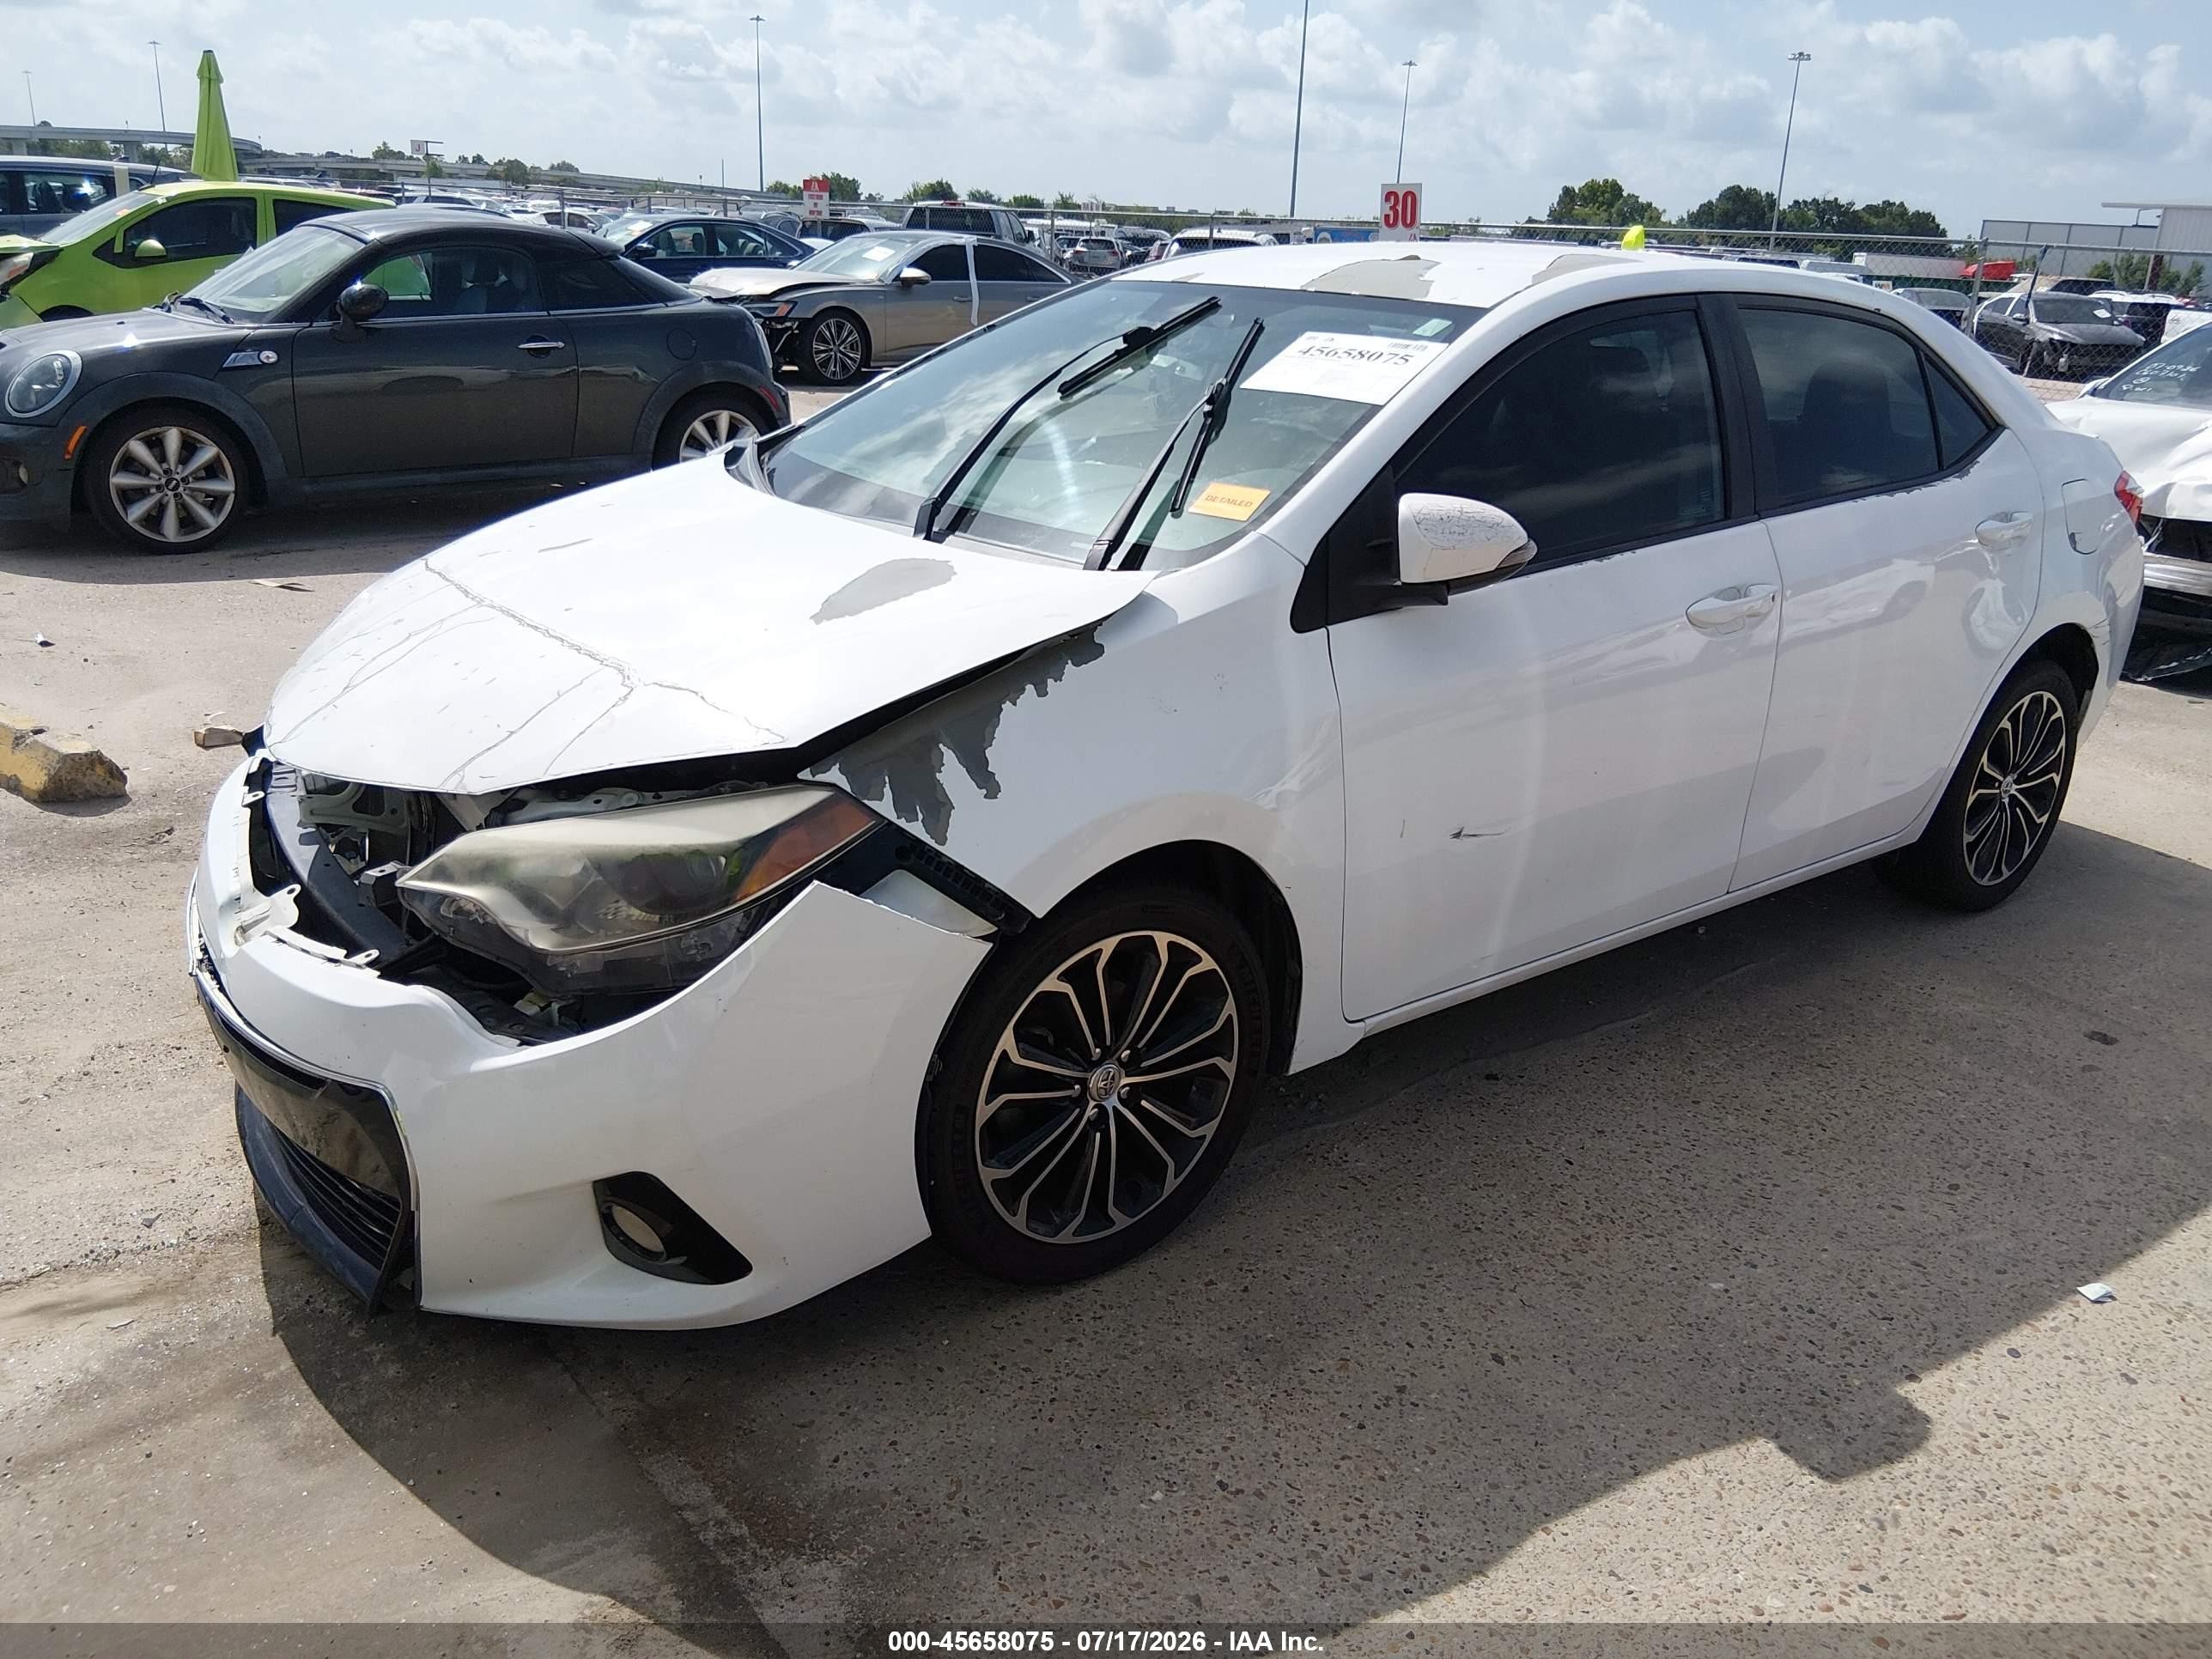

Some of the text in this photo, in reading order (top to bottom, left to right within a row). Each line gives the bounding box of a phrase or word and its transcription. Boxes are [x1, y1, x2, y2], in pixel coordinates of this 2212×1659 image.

[1383, 190, 1418, 229] 30
[1298, 345, 1414, 365] 45658075
[1205, 495, 1254, 507] DETAILED
